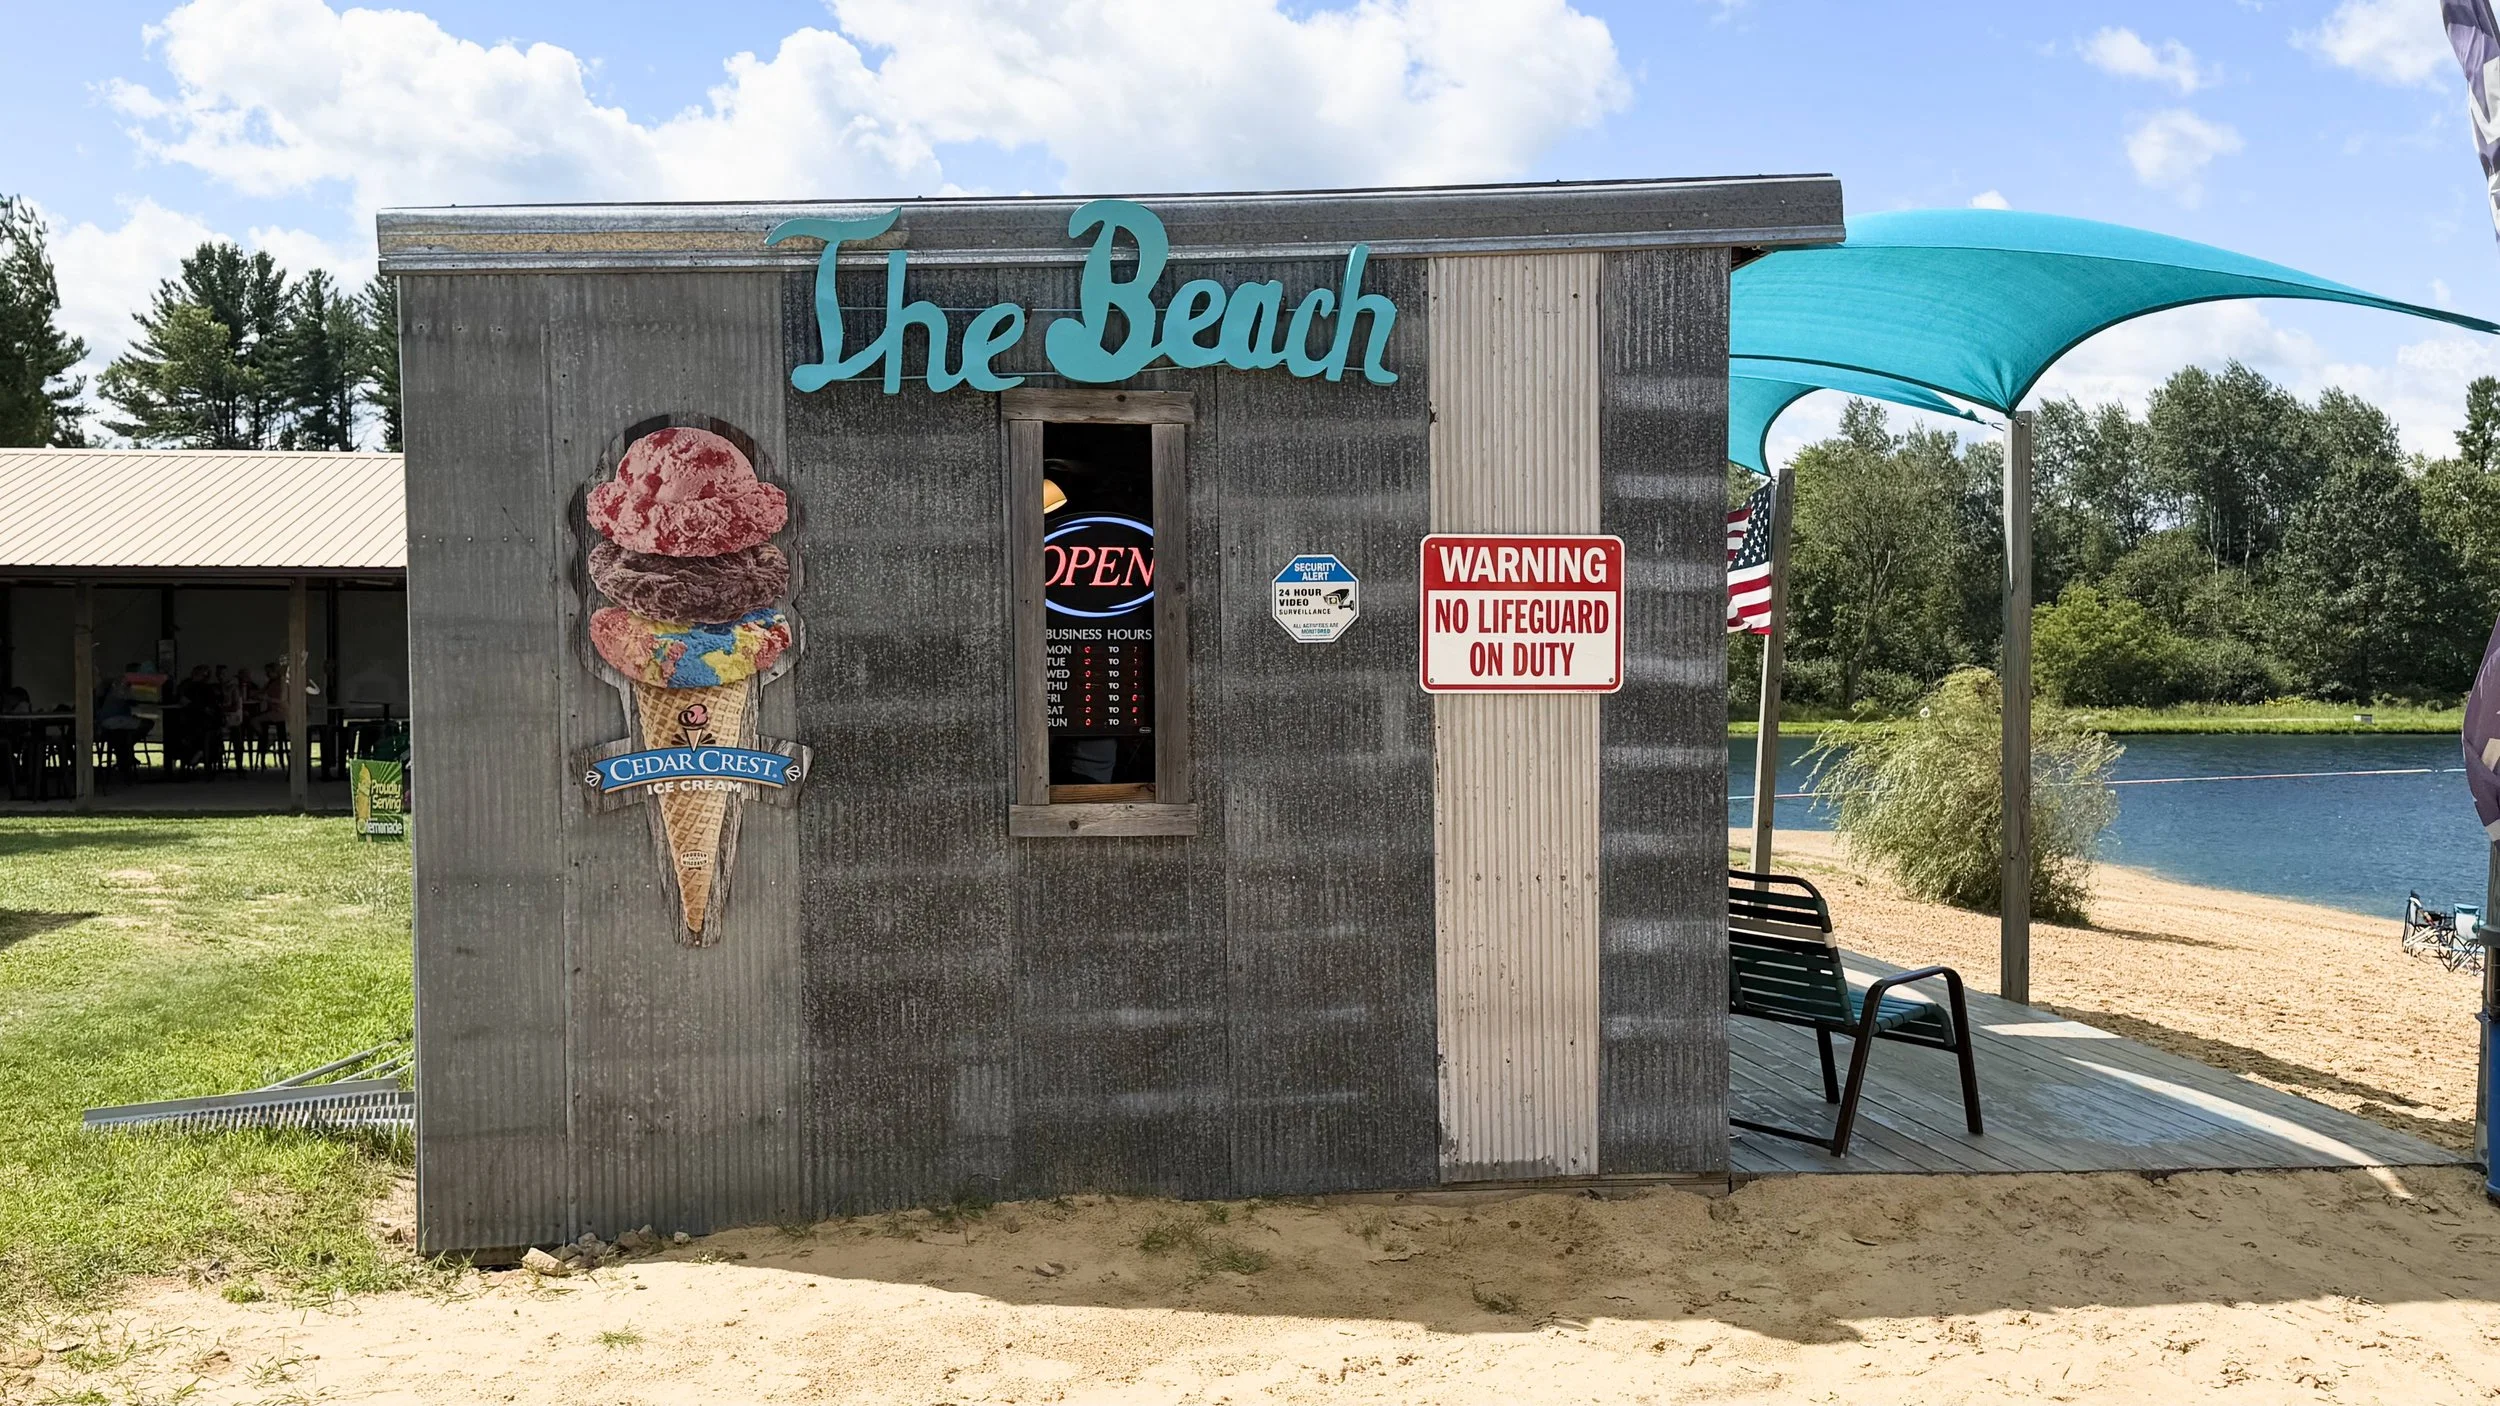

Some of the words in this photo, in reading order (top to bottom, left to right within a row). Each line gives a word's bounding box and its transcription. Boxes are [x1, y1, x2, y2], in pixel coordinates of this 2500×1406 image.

[765, 206, 1025, 395] The
[1045, 200, 1398, 386] Beach
[1294, 562, 1336, 572] SECURITY
[1439, 546, 1607, 584] WARNING
[1301, 572, 1329, 581] ALERT
[1435, 598, 1468, 634] NO
[1478, 598, 1609, 634] LIFEGUARD
[1046, 629, 1102, 640] BUSINESS
[1107, 629, 1152, 640] HOURS
[1047, 645, 1072, 654] MON
[1047, 657, 1066, 666] TUE
[1470, 641, 1502, 677] ON
[1513, 642, 1575, 676] DUTY
[1047, 669, 1070, 678] WED
[1047, 681, 1068, 690] THU
[1108, 694, 1120, 702] TO
[609, 753, 696, 782] CEDAR
[698, 750, 778, 778] CREST
[371, 780, 401, 798] Proudly
[647, 781, 674, 796] ICE
[678, 780, 742, 793] CREAM
[372, 795, 401, 813] Serving
